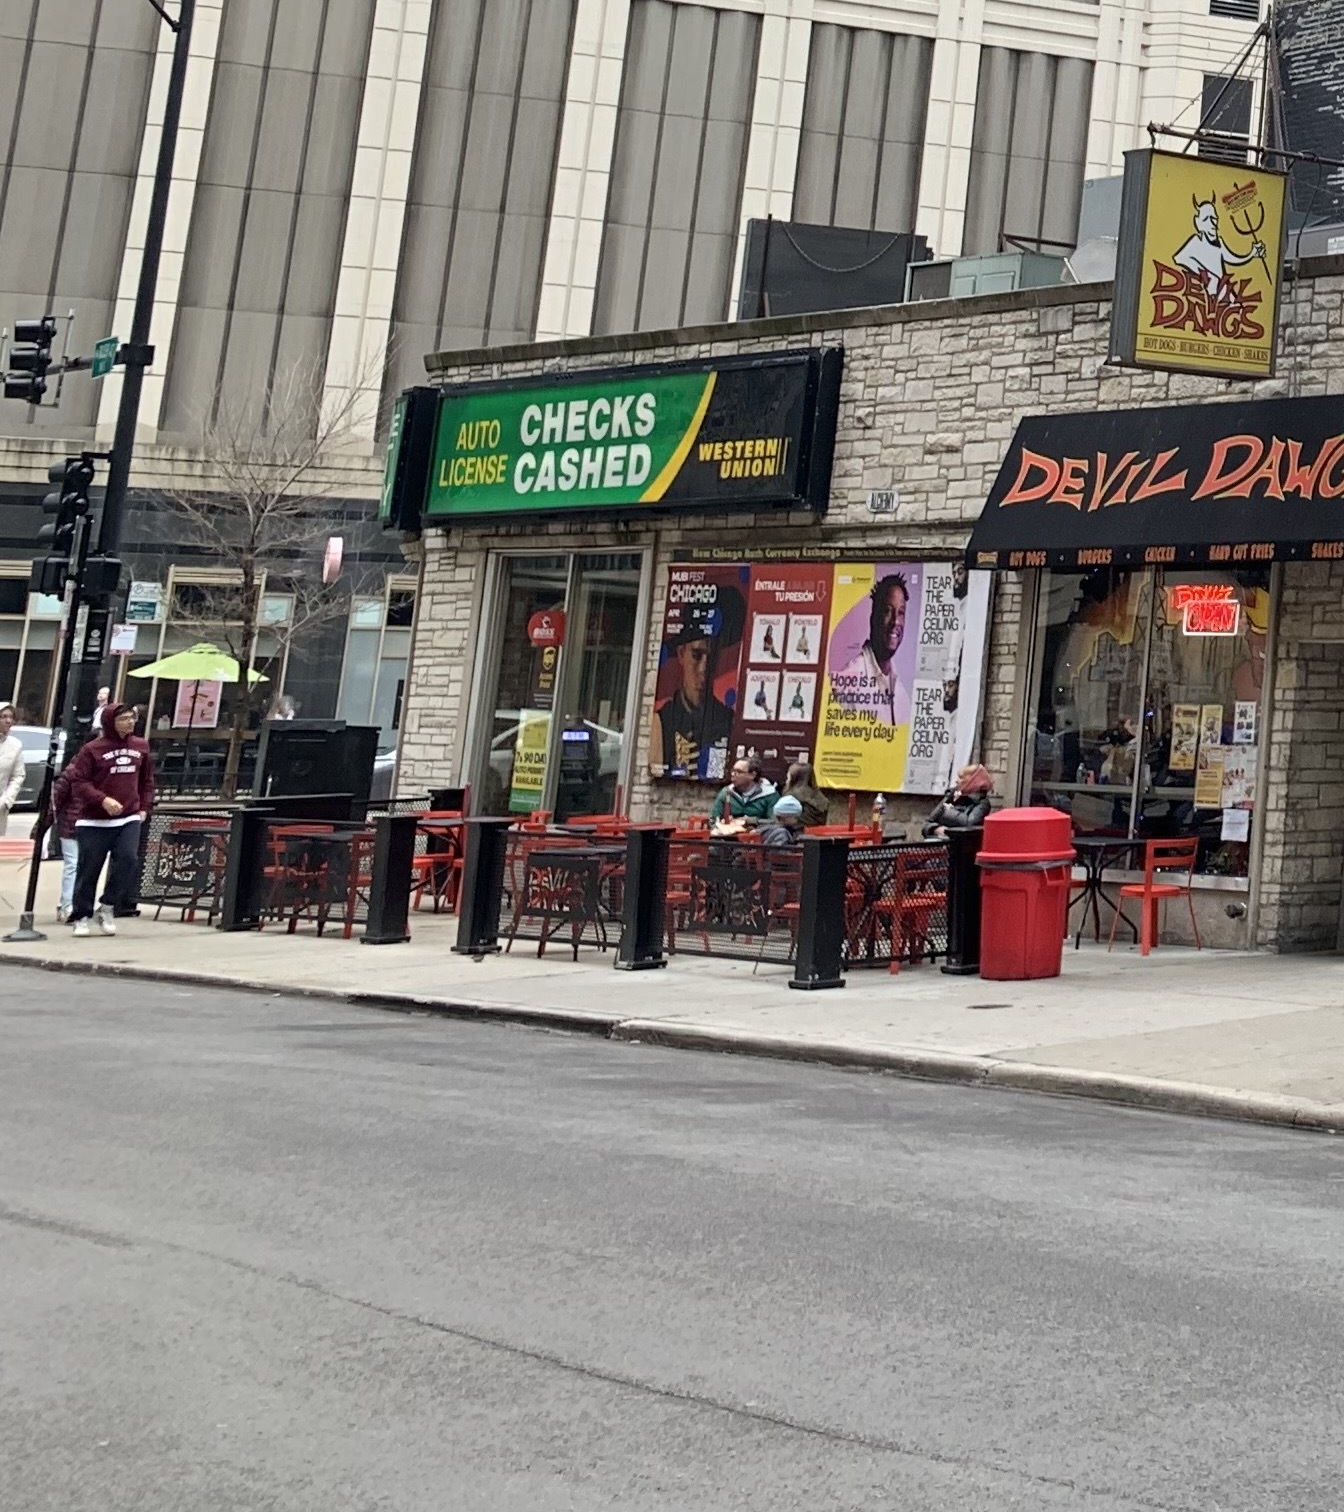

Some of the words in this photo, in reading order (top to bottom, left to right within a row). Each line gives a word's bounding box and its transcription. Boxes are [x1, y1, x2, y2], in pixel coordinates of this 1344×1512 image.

[1150, 260, 1263, 303] DEVIL
[1150, 294, 1265, 340] DAWGS
[1143, 337, 1158, 349] HOT
[1160, 338, 1176, 352] DOGS
[1180, 341, 1210, 355] BURGERS
[1213, 345, 1241, 358] CHICKEN
[1243, 348, 1269, 361] SHAKES
[520, 392, 657, 447] CHECKS
[456, 419, 501, 451] AUTO
[698, 438, 779, 461] WESTERN
[438, 455, 508, 488] LICENSE
[513, 443, 652, 495] CASHED
[719, 457, 777, 480] UNION
[1000, 447, 1188, 512] DEVIL
[712, 548, 742, 560] Chicago
[765, 548, 800, 559] Currency
[803, 547, 840, 559] Exchange
[1009, 551, 1024, 566] HOT
[1025, 551, 1047, 566] DOGS
[1077, 548, 1112, 565] BURGERS
[1144, 546, 1176, 562] CHICKEN
[1209, 544, 1231, 560] HAND
[1233, 544, 1248, 560] CUT
[1250, 543, 1275, 560] FRIES
[1311, 542, 1344, 558] SHAKES
[690, 571, 705, 582] FEST
[927, 576, 952, 589] TEAR
[670, 583, 717, 603] CHICAGO
[925, 591, 944, 603] THE
[925, 604, 955, 617] PAPER
[923, 618, 959, 631] CEILING
[920, 632, 944, 645] .ORG
[859, 673, 869, 687] is
[870, 676, 877, 688] a
[827, 688, 871, 706] practice
[873, 688, 895, 705] that
[917, 688, 942, 702] TEAR
[826, 708, 857, 721] saves
[859, 708, 878, 724] my
[915, 702, 934, 716] THE
[824, 722, 840, 738] life
[842, 725, 871, 742] every
[914, 717, 945, 730] PAPER
[912, 731, 949, 745] CEILING
[909, 745, 934, 758] .ORG
